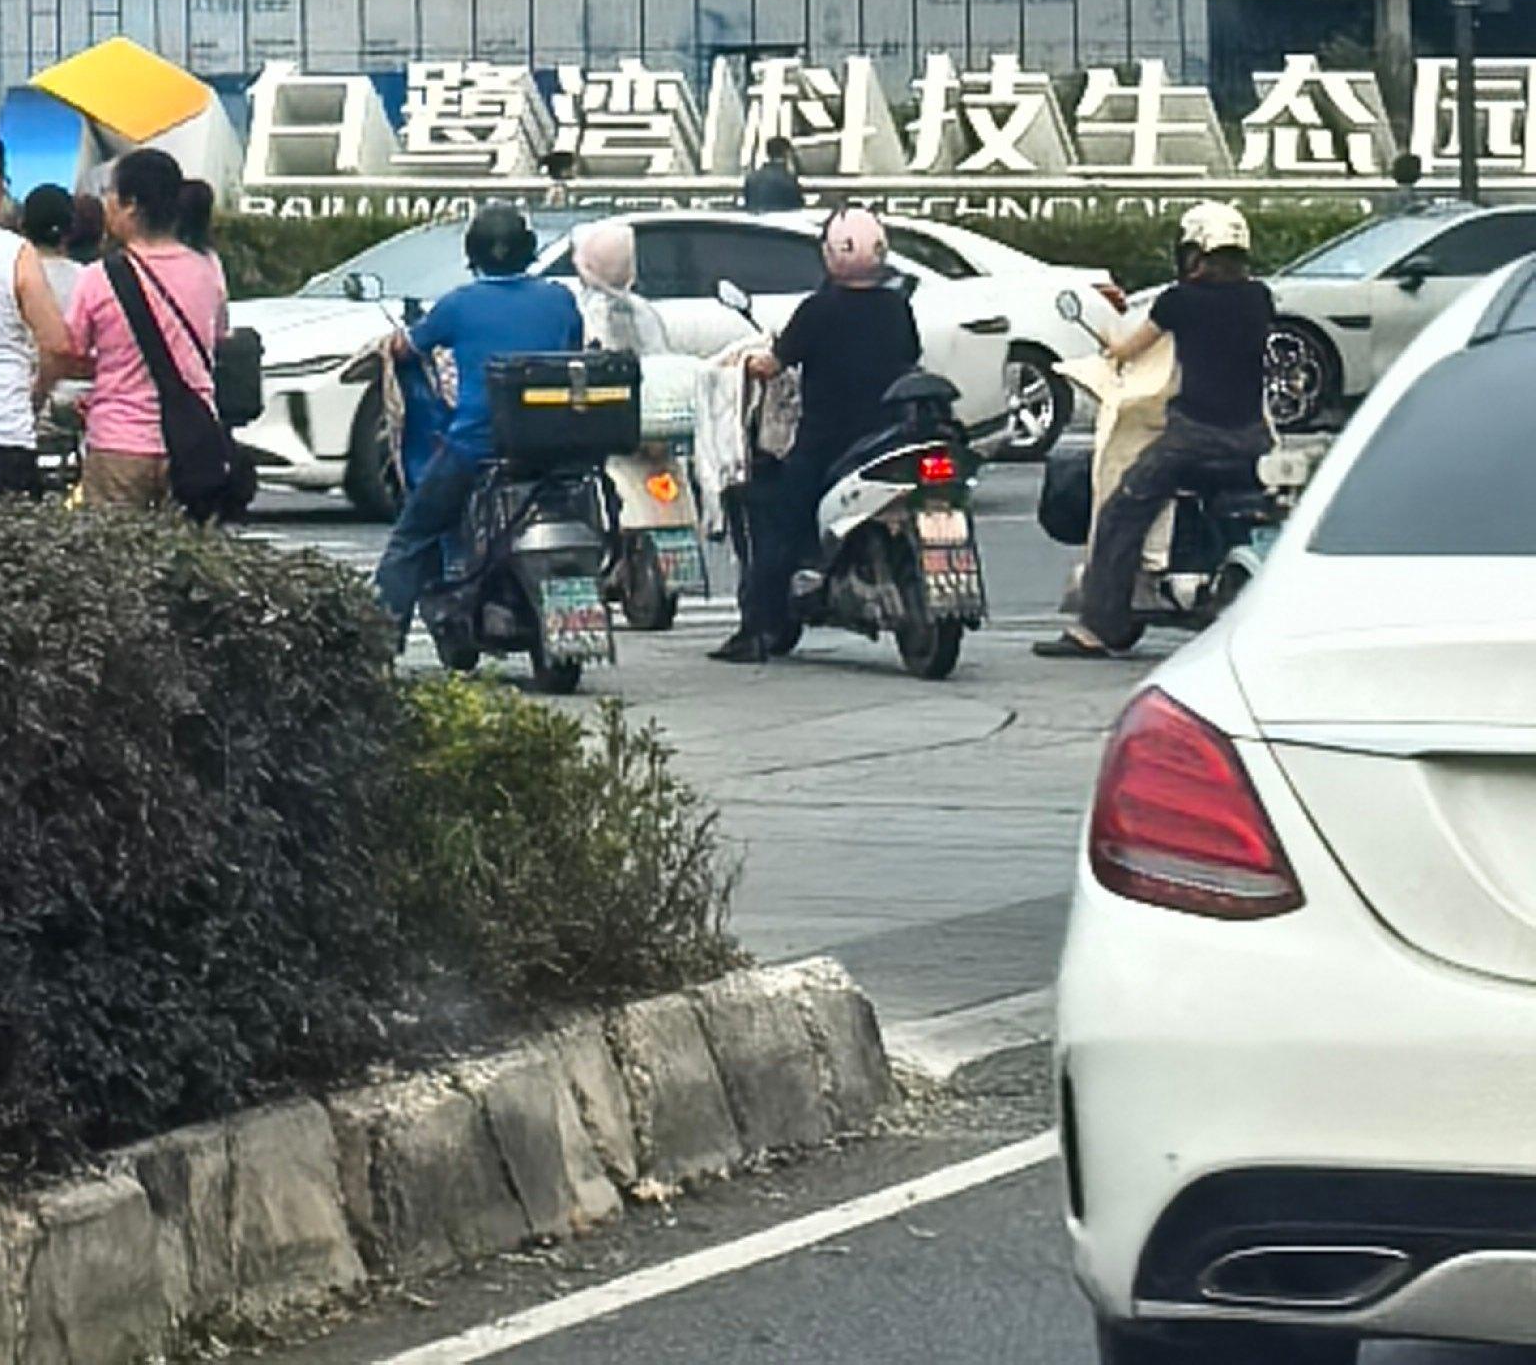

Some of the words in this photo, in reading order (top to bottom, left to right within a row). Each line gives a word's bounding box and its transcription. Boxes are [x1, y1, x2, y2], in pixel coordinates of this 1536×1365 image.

[244, 54, 1536, 176] 白鹭湾科技生态园
